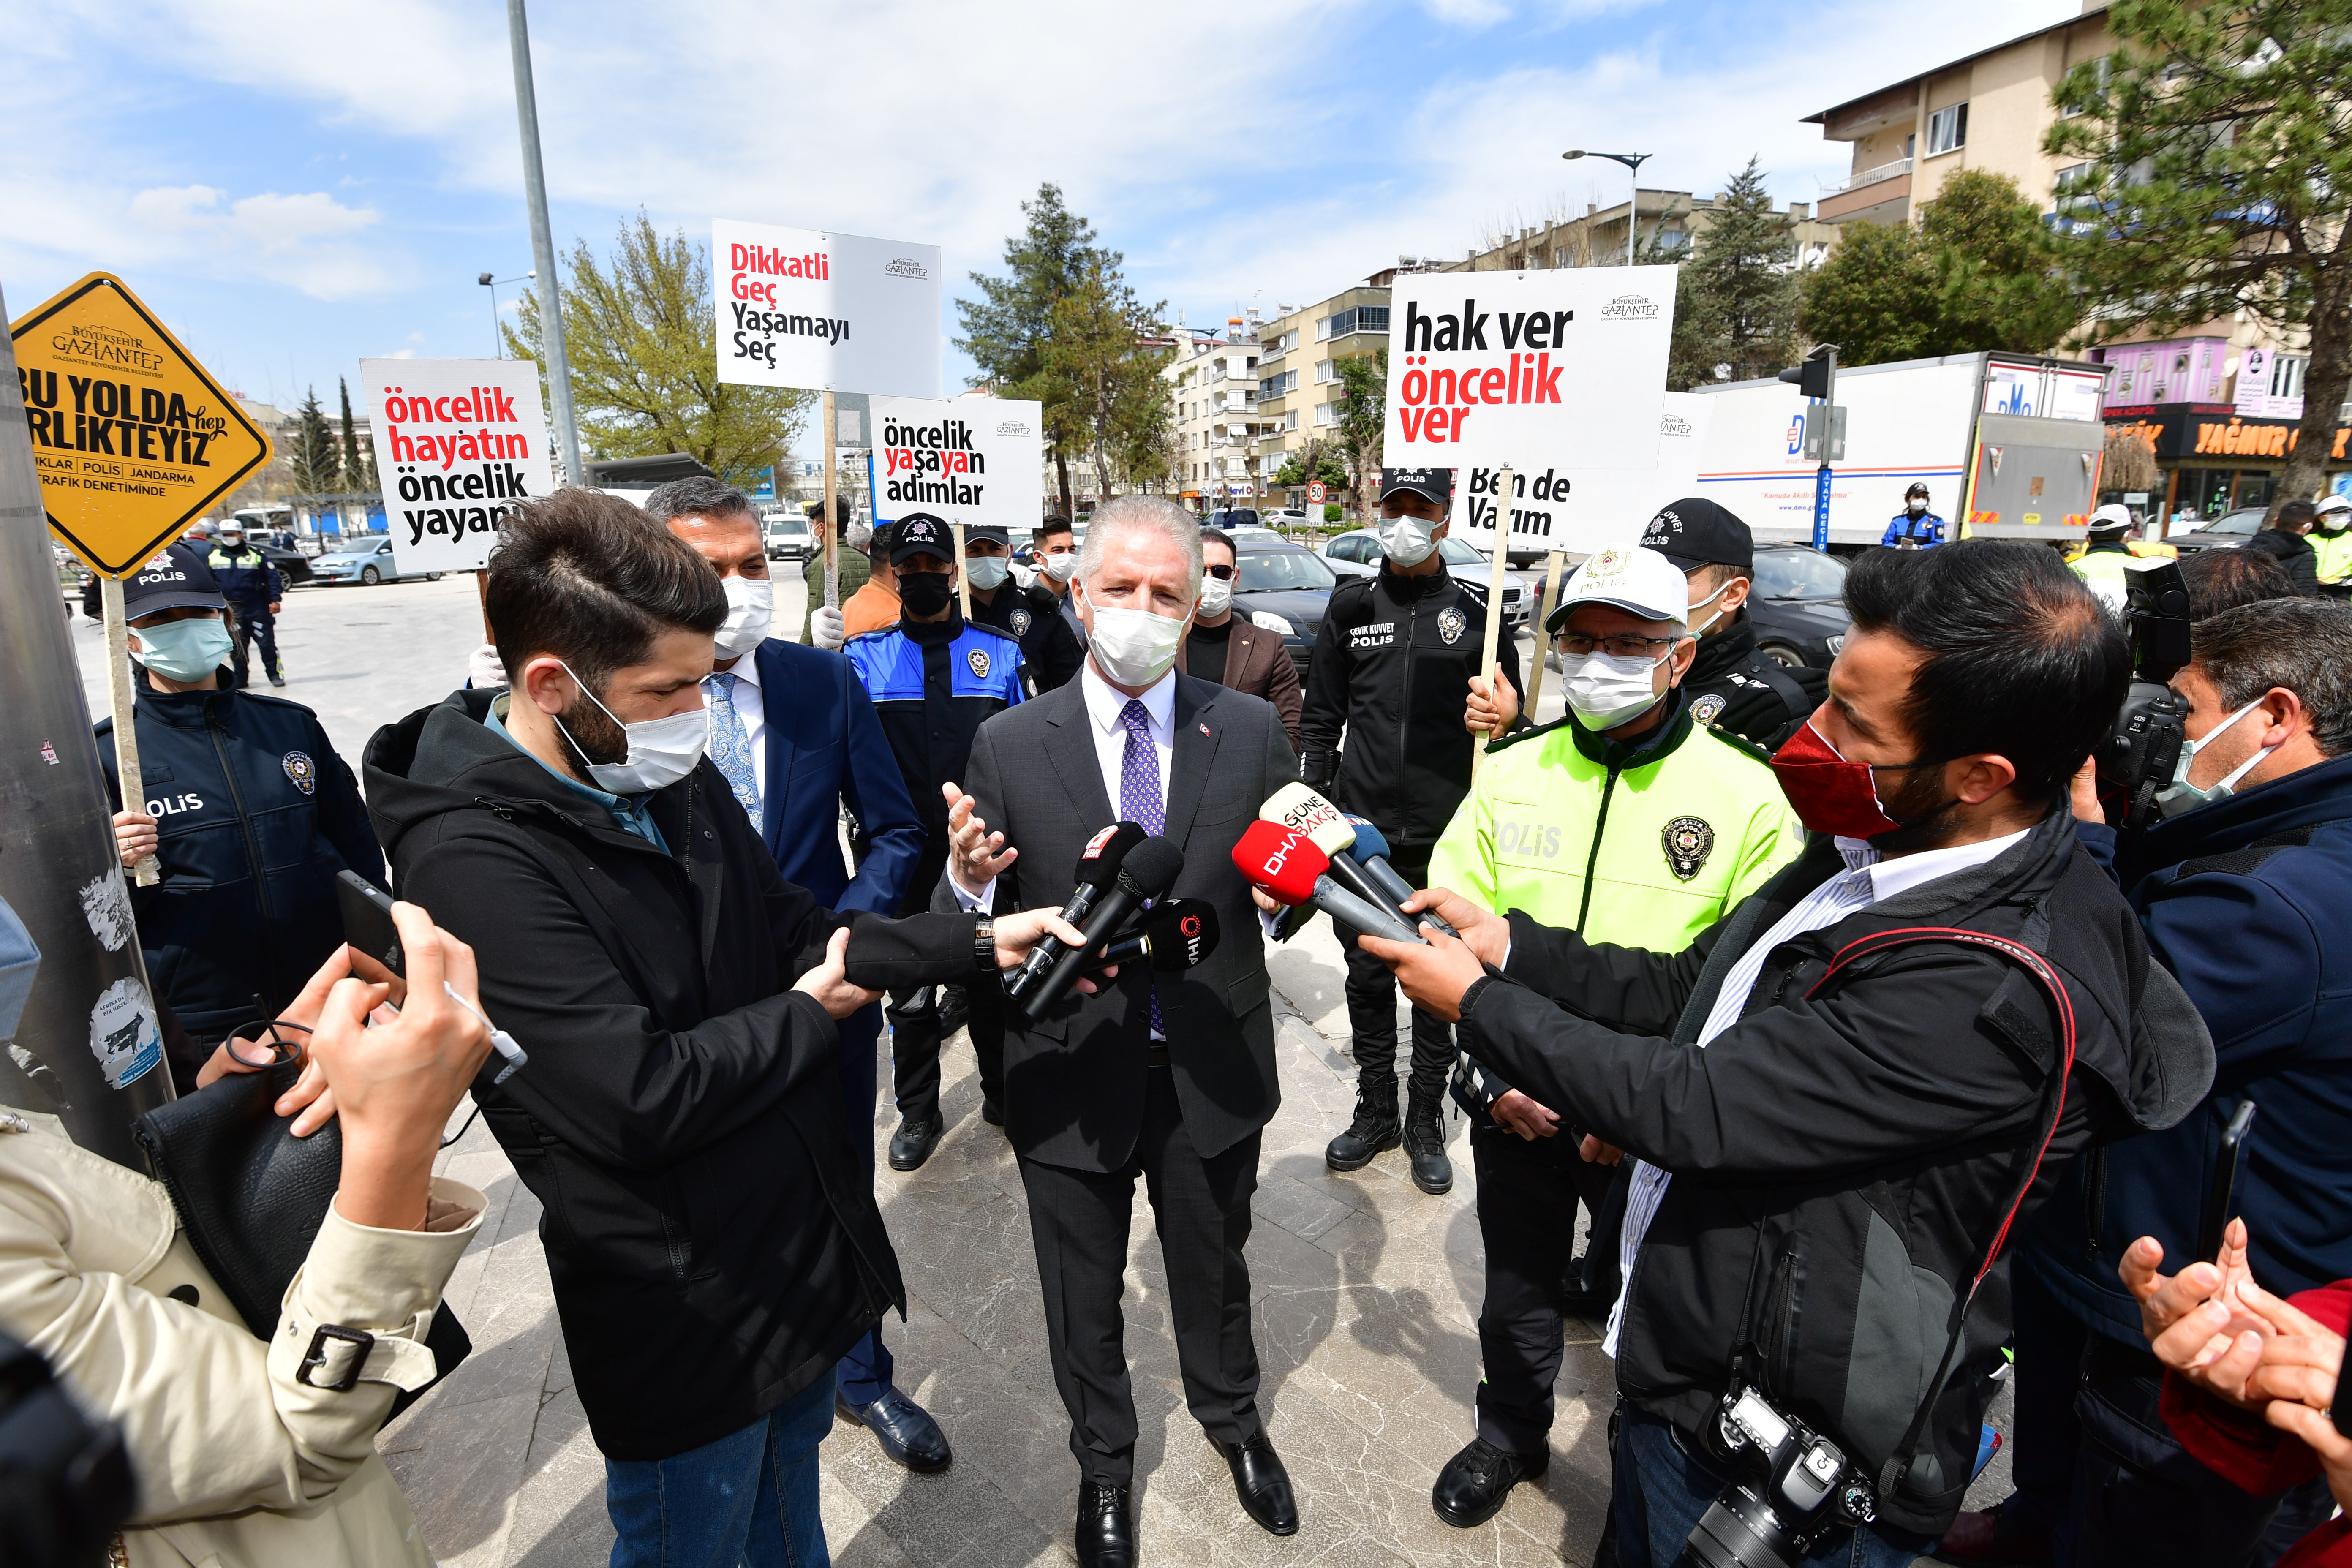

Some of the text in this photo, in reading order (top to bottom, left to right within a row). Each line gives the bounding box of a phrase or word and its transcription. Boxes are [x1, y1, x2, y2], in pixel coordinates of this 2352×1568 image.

[731, 243, 828, 280] Dikkatli
[731, 273, 777, 310] Geç
[731, 301, 849, 346] Yaşamayı
[1405, 299, 1573, 352] hak ver
[1602, 304, 1658, 316] GAZİANTEP
[52, 336, 163, 370] GAZİANTEP
[72, 326, 143, 349] BÜYÜKŞEHİR
[734, 331, 776, 370] Seç
[52, 354, 163, 379] GAZİANTEP BÜYÜKŞEHİR BELEDİYESİ
[1402, 352, 1565, 406] öncelik
[67, 375, 190, 429] YOLDA
[384, 387, 518, 423] öncelik
[25, 406, 210, 467] RLİKTEYİZ
[187, 405, 228, 441] hep
[884, 417, 974, 450] öncelik
[1399, 407, 1470, 443] ver
[2195, 417, 2289, 457] YAĞMUR
[388, 425, 528, 471] hayatın
[885, 448, 985, 480] yaşayan
[83, 462, 120, 476] POLİS
[130, 468, 195, 484] JANDARMA
[84, 479, 166, 497] DENETİMİNDE
[398, 463, 528, 502] öncelik
[887, 474, 984, 505] adımlar
[1533, 468, 1571, 502] de
[1312, 487, 1322, 498] 50
[906, 535, 934, 543] POLİS
[139, 571, 186, 586] POLİS
[1350, 622, 1395, 638] ÇEVİK KUVVET
[1351, 635, 1394, 647] POLİS
[146, 793, 204, 818] OLİS
[1284, 796, 1325, 826] GÜNE
[1083, 848, 1101, 858] HBR
[1263, 833, 1303, 876] DHA
